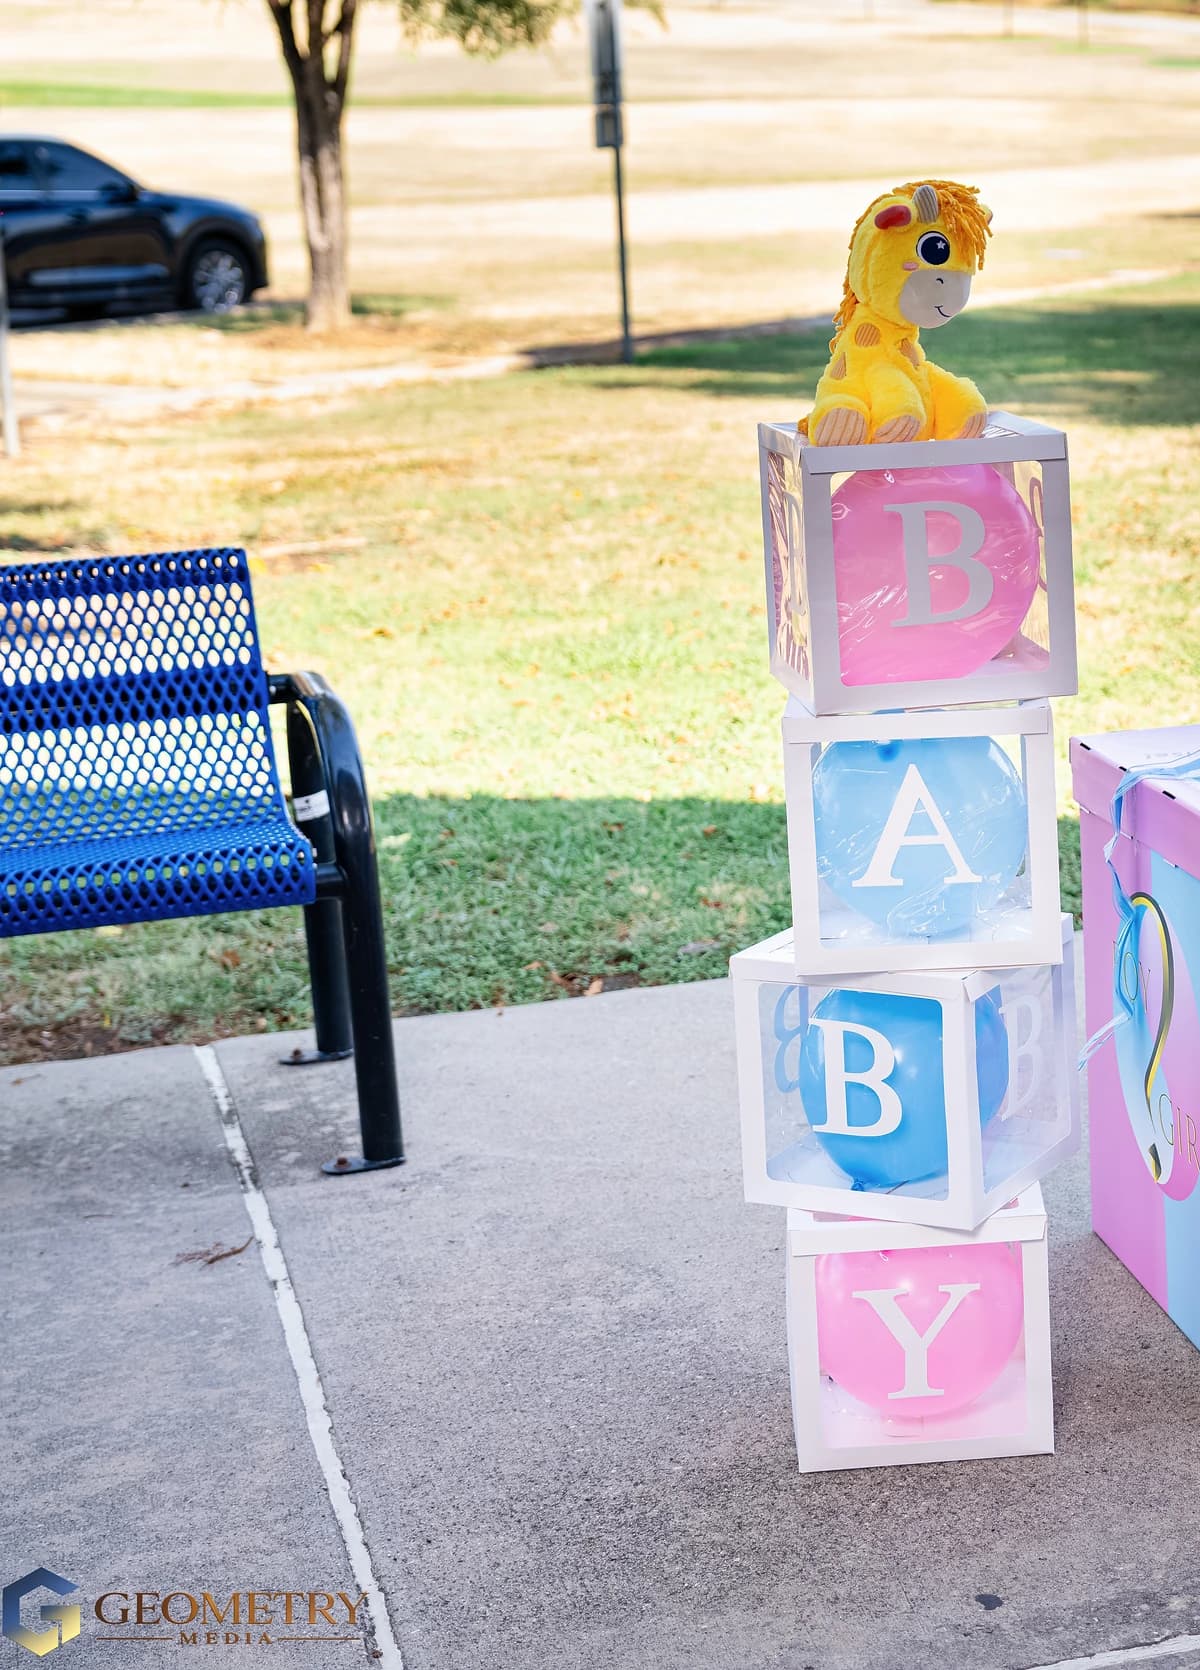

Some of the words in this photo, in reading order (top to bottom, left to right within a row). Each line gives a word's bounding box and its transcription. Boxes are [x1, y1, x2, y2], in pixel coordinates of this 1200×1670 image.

[883, 501, 994, 628] B
[852, 763, 982, 888] A
[808, 1017, 902, 1137] B
[998, 994, 1045, 1122] B
[852, 1283, 981, 1400] Y
